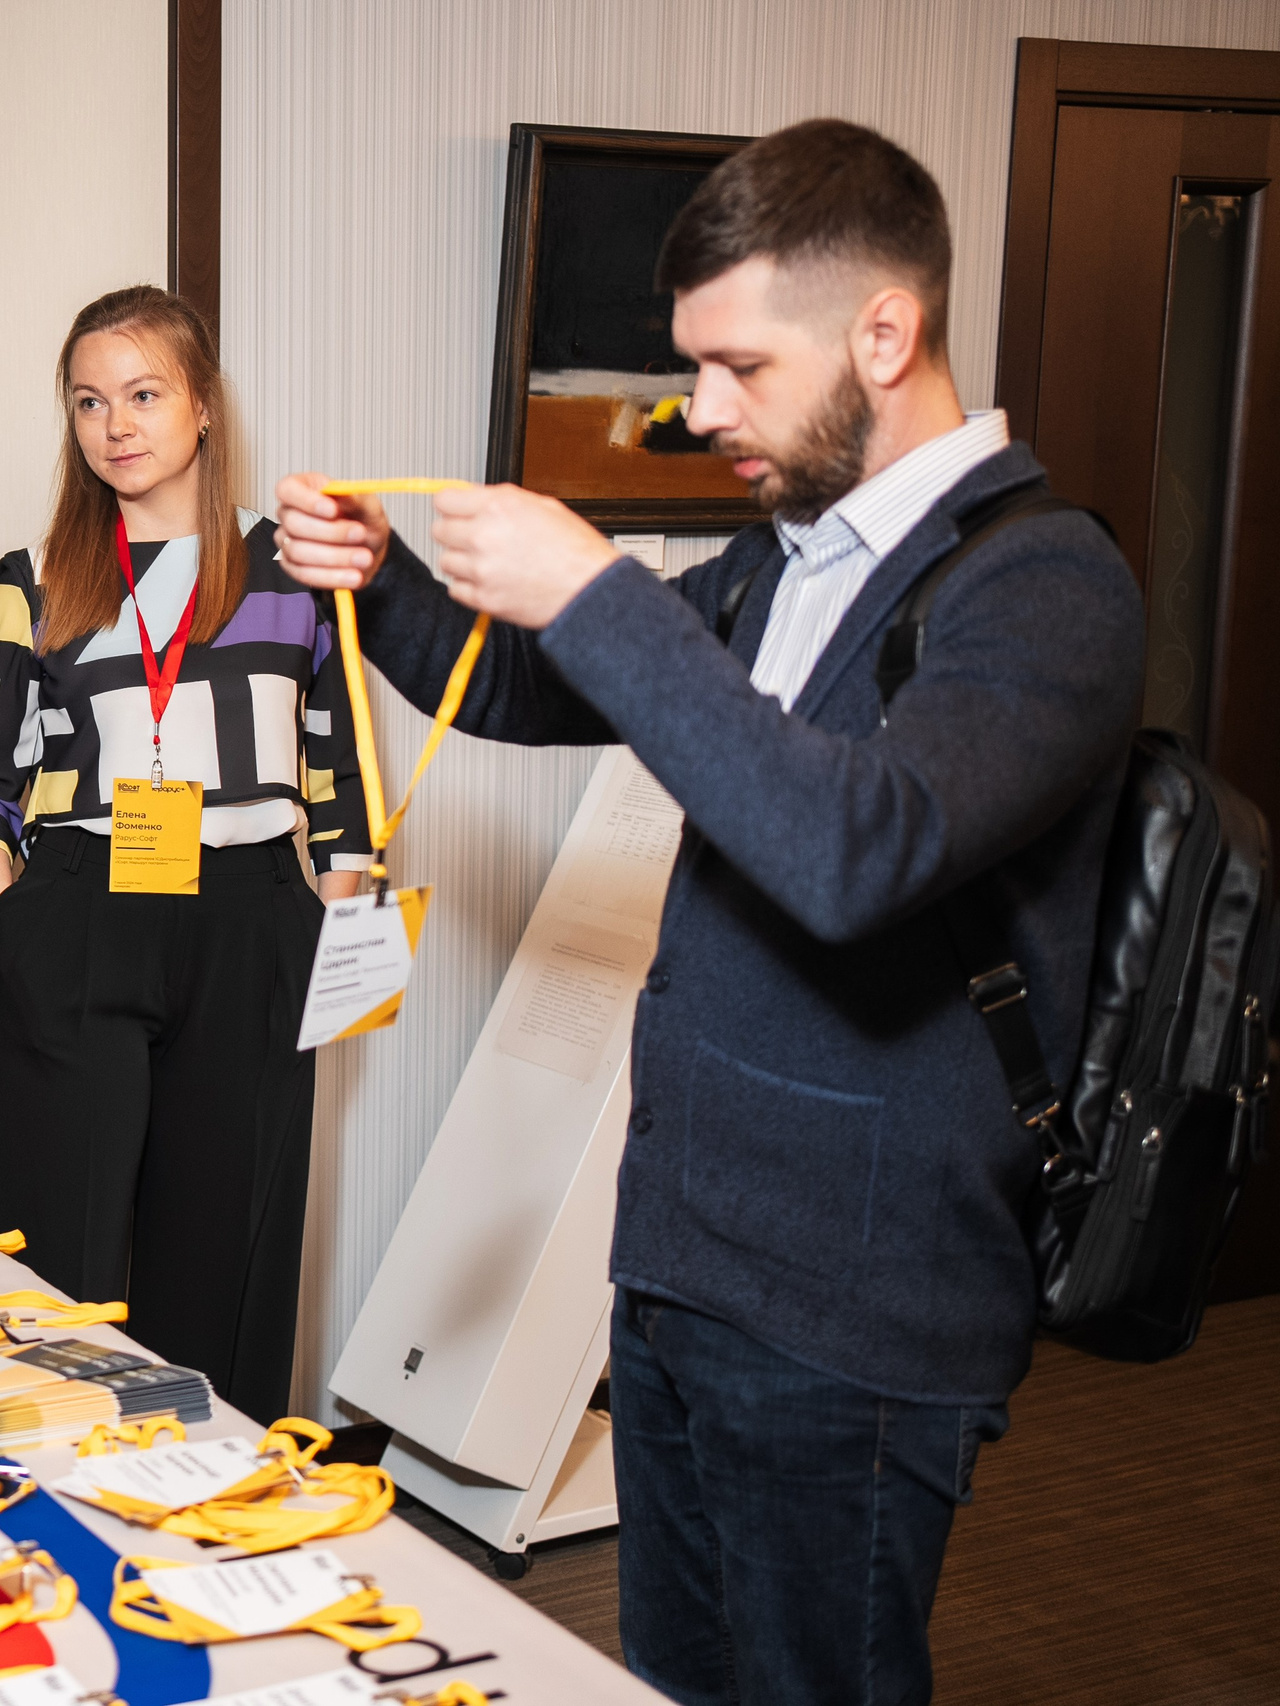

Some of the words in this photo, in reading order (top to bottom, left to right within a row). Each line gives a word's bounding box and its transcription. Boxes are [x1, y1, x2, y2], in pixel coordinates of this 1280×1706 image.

[116, 811, 147, 819] Елена
[115, 822, 163, 831] Фоменко
[115, 834, 158, 843] Рарус-Софт
